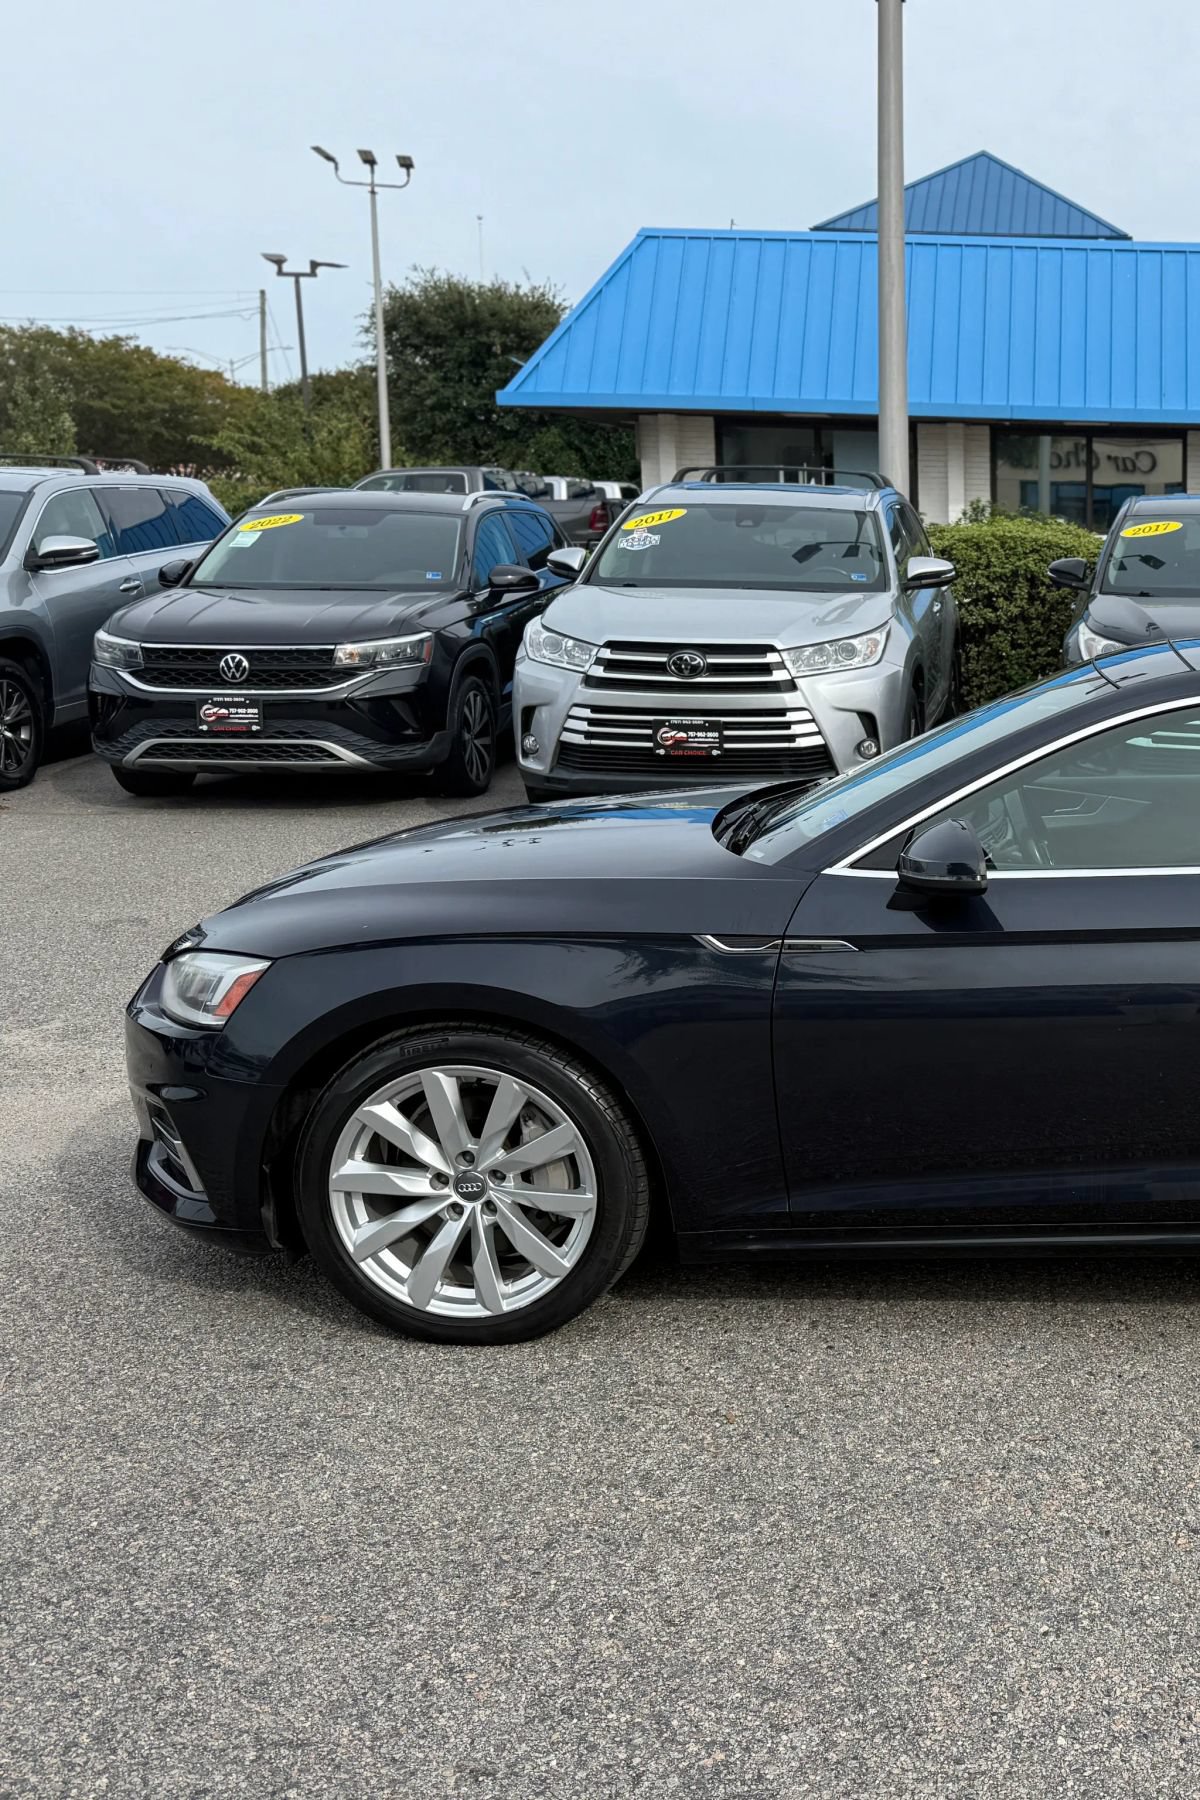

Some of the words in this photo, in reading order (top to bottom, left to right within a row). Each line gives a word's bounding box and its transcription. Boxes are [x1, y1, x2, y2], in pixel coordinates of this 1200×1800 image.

[249, 515, 293, 530] 2022
[634, 510, 674, 528] 2017
[1131, 523, 1170, 536] 2017
